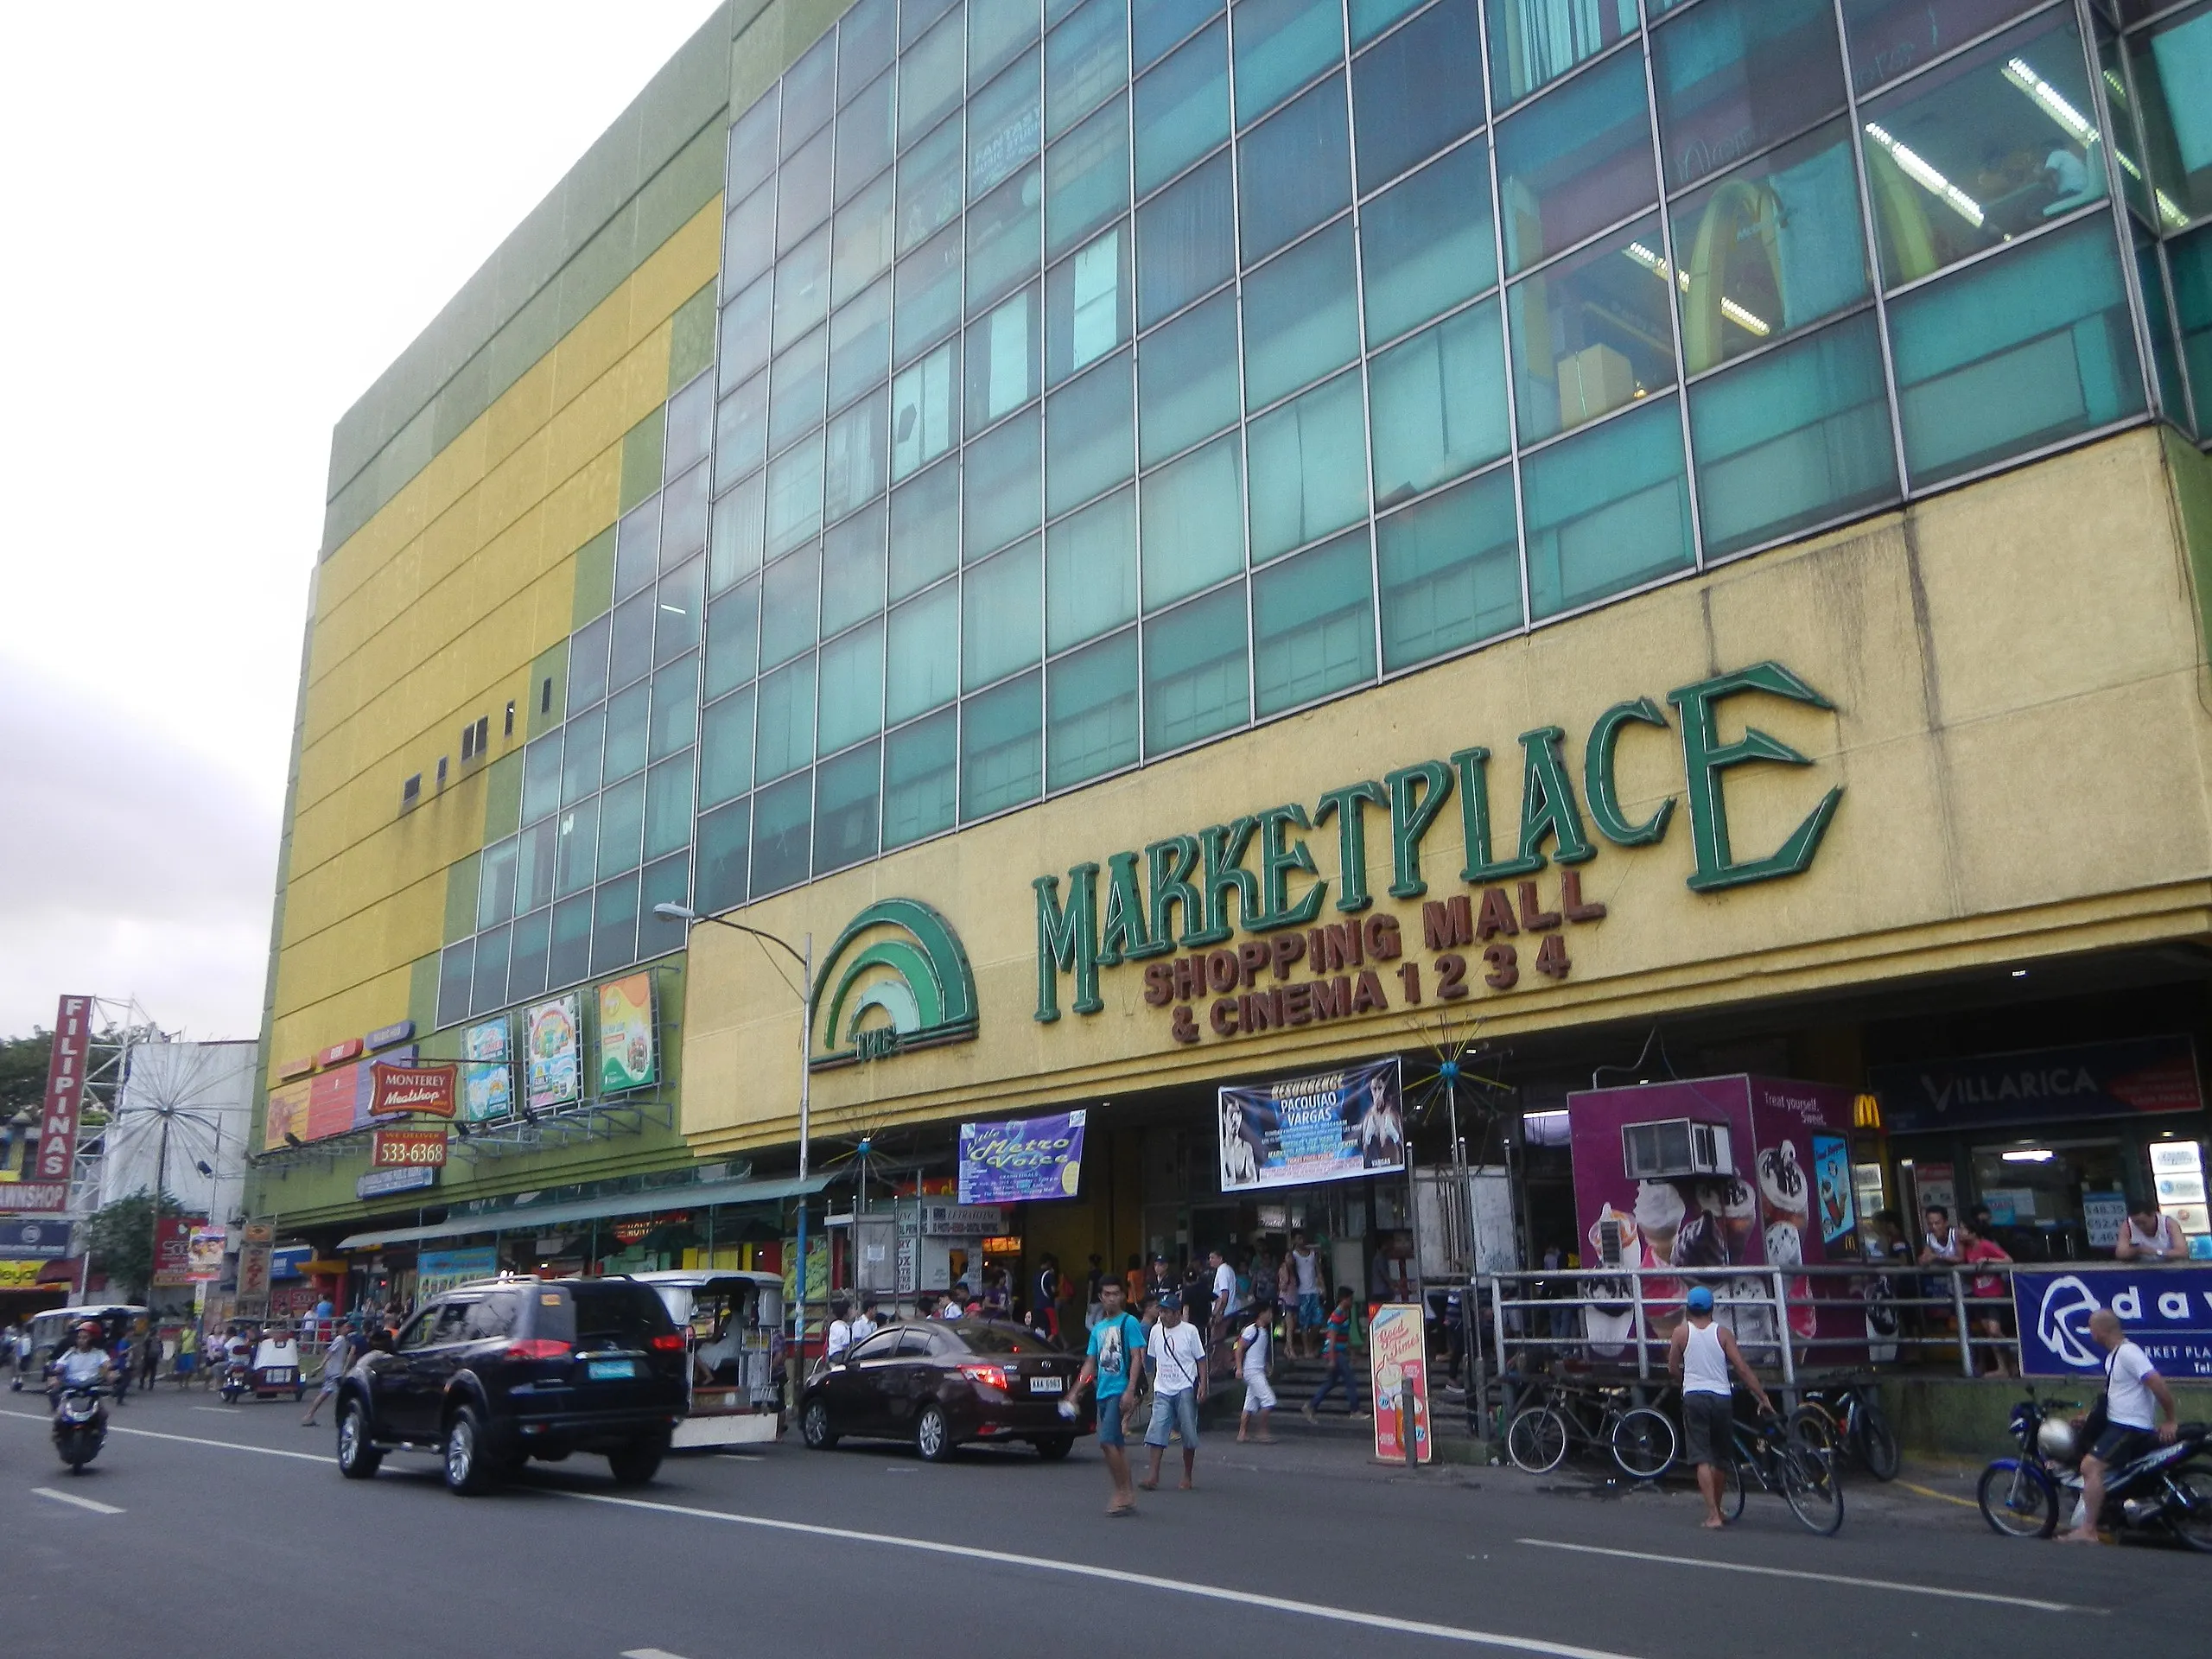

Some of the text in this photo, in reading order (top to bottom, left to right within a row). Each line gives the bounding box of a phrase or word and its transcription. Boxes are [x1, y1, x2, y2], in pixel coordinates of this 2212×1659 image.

[1033, 660, 1845, 1023] MARKETPLACE
[1144, 870, 1606, 1006] SHOPPING MALL
[1172, 1005, 1200, 1044] &
[1209, 969, 1389, 1036] CINEMA
[43, 998, 83, 1175] FILIPINAS
[385, 1074, 446, 1087] MONTEREY
[1920, 1067, 2099, 1112] VILLARICA
[384, 1088, 440, 1106] Meatshop
[1281, 1091, 1337, 1114] PACQUIAO
[1764, 1091, 1784, 1108] Treat
[1287, 1107, 1332, 1125] VARGAS
[381, 1142, 442, 1162] 533-6368
[969, 1138, 1070, 1160] Metro
[986, 1154, 1069, 1167] Voice
[1377, 1318, 1406, 1349] Good
